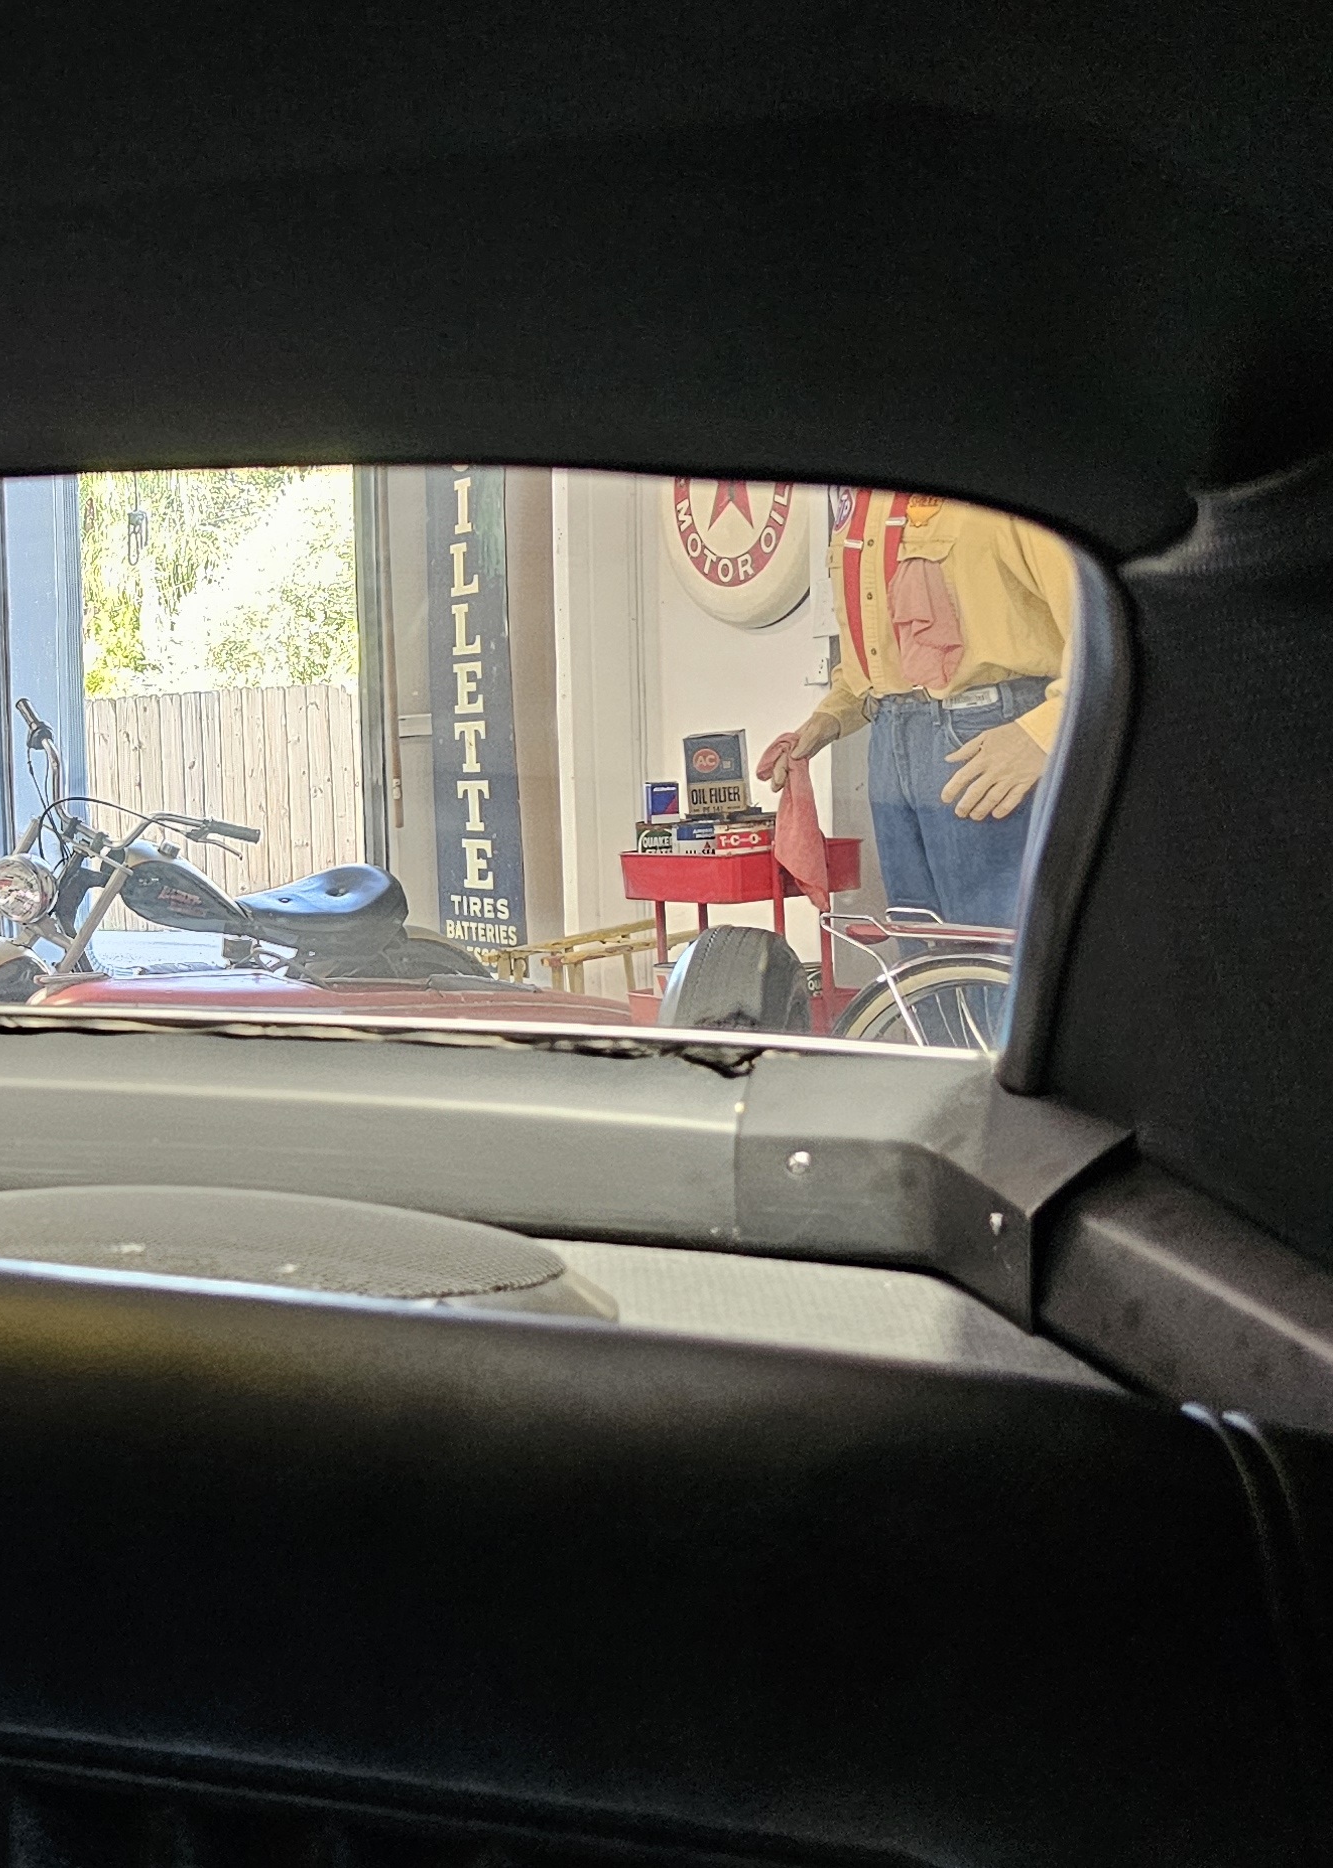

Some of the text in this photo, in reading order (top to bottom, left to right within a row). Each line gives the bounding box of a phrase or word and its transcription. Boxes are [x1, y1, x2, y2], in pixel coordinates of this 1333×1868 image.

[676, 484, 790, 583] MOTOR OIL
[450, 465, 494, 890] ILLETTE
[697, 755, 716, 766] AC
[691, 786, 741, 805] OIL FILTER
[450, 894, 509, 920] TIRES
[446, 920, 517, 946] BATTERIES
